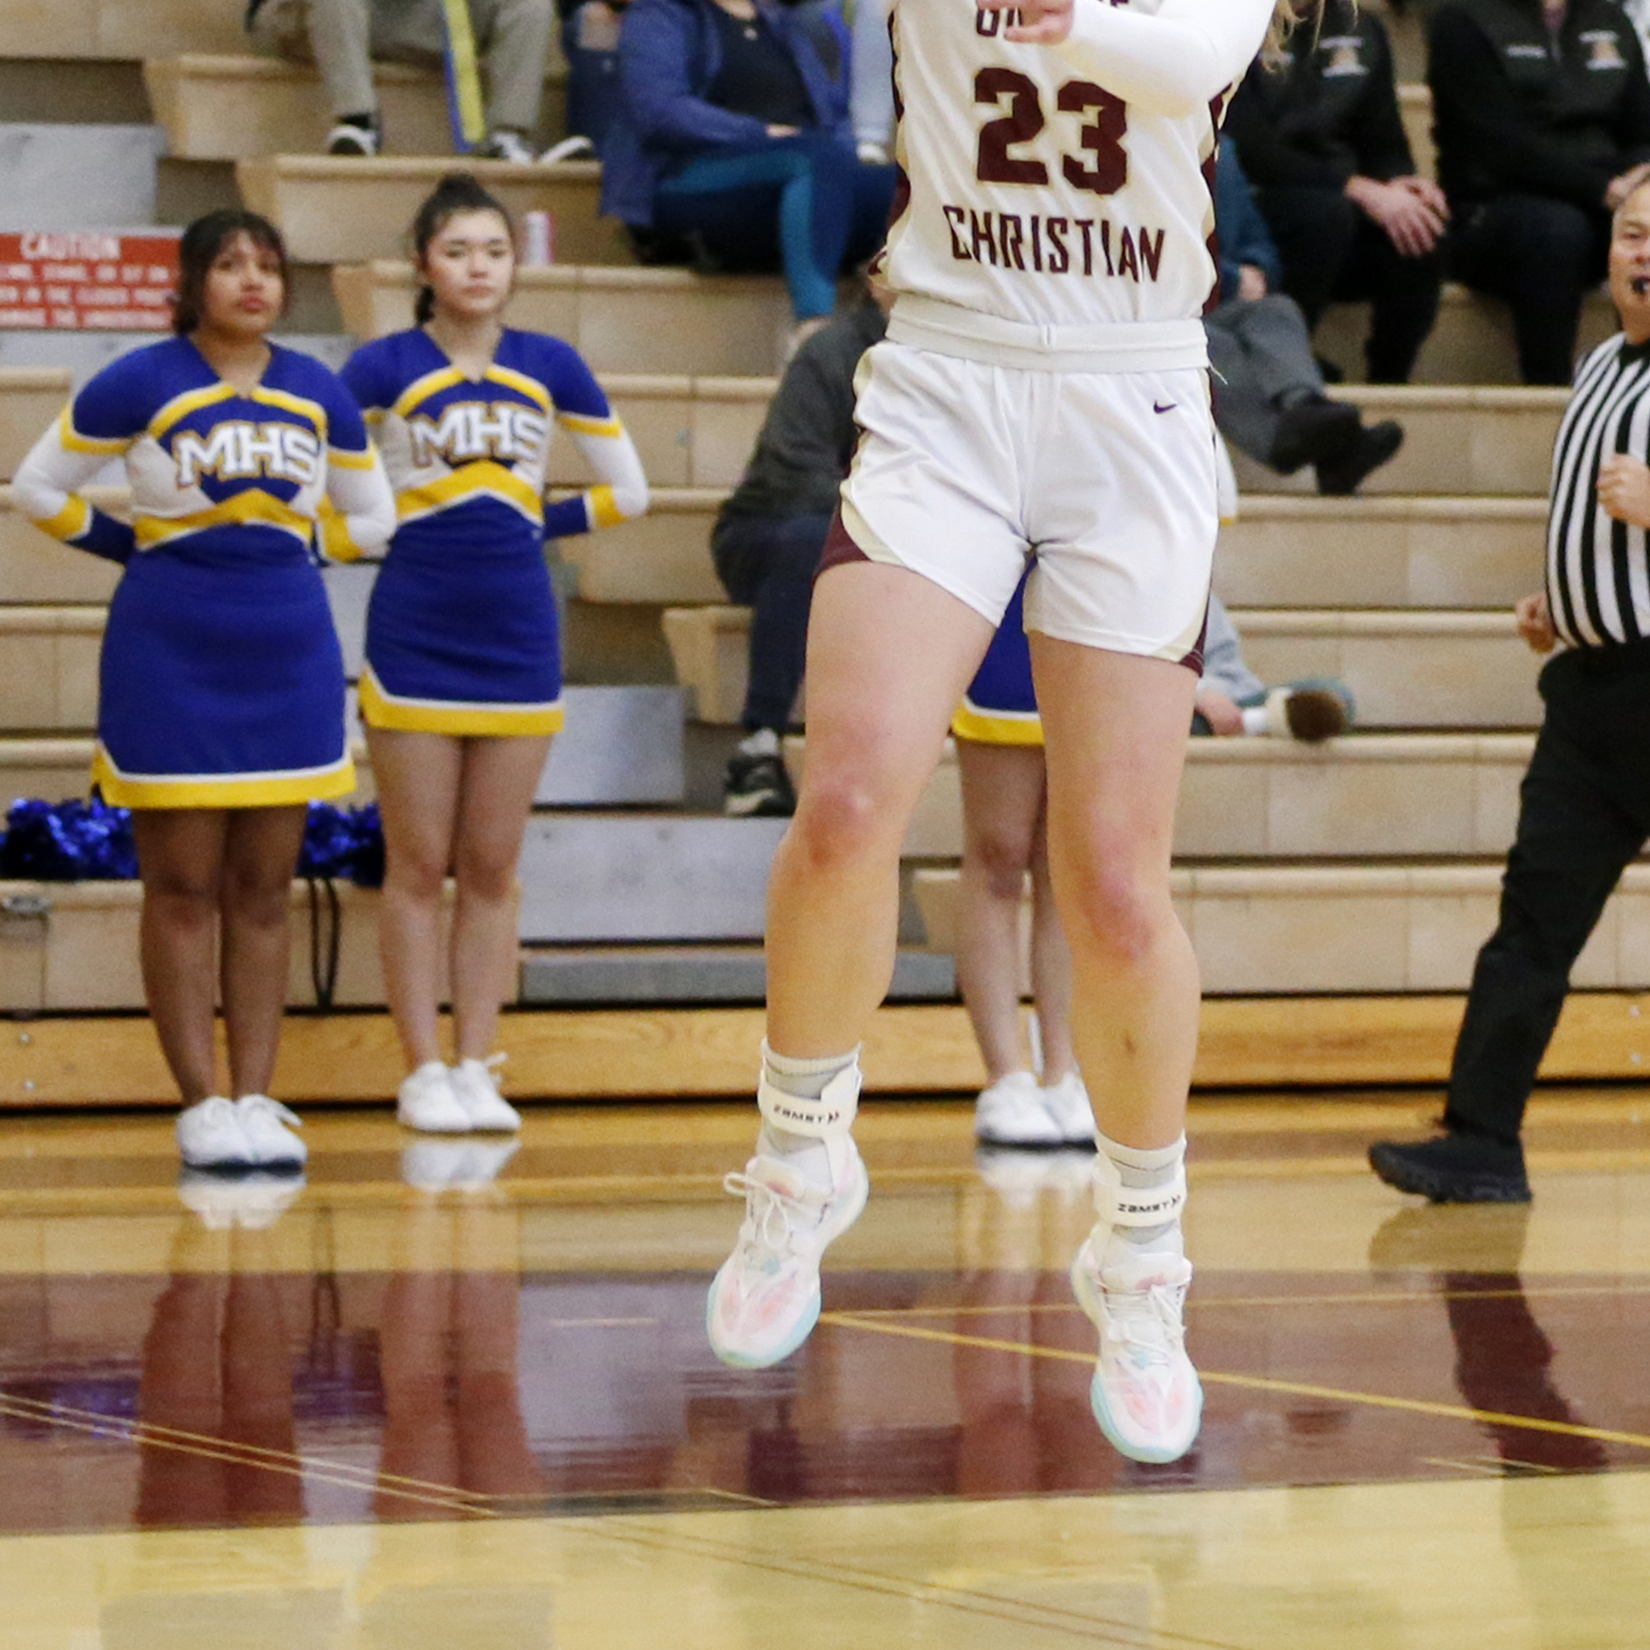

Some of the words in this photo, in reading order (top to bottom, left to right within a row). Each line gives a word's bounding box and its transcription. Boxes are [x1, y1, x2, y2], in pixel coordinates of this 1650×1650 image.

[974, 66, 1129, 196] 23
[943, 204, 1165, 282] CHRISTIAN
[173, 421, 322, 490] MHS
[410, 401, 548, 468] MHS
